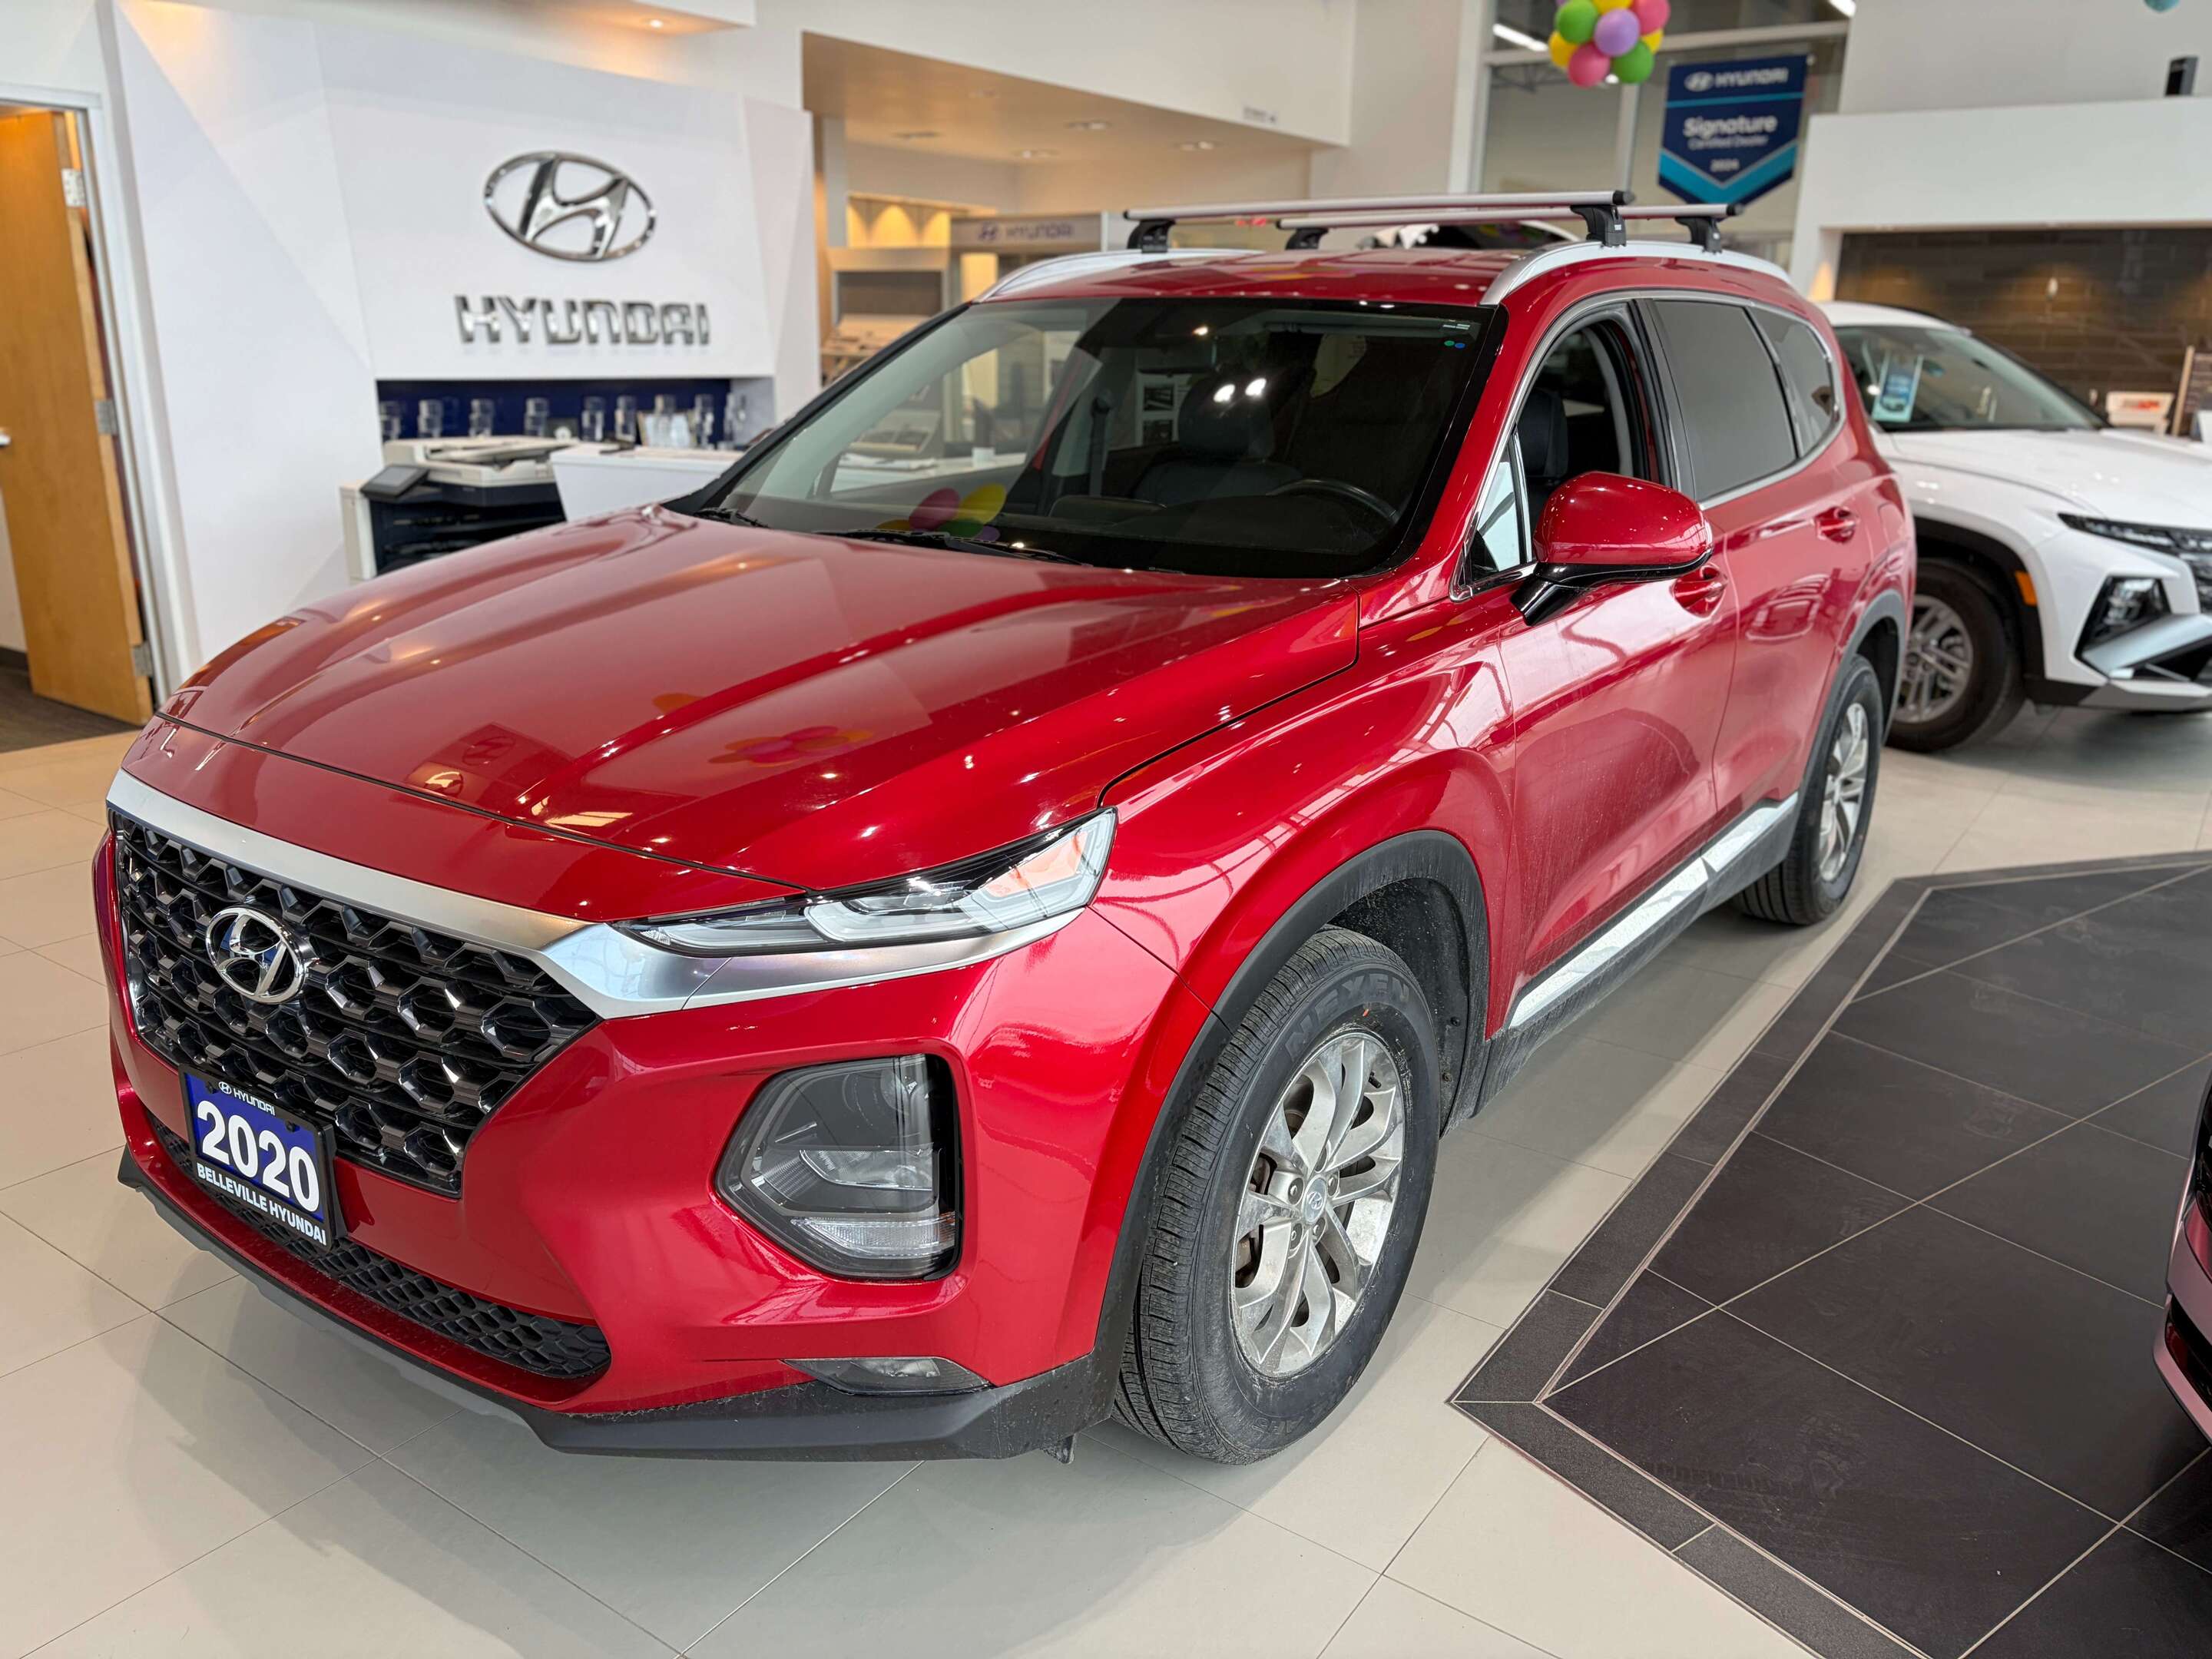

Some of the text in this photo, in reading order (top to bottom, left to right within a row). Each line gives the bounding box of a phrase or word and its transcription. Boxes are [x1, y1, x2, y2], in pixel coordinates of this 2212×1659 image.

[1714, 68, 1789, 88] HYUNDAI
[1684, 115, 1778, 139] Signature
[455, 294, 711, 346] HYUNDAI
[1285, 972, 1410, 1063] NEXEN
[233, 1088, 275, 1116] HYUNDAI
[197, 1100, 320, 1213] 2020
[196, 1161, 327, 1247] BELLEVILLE HYUNDAI
